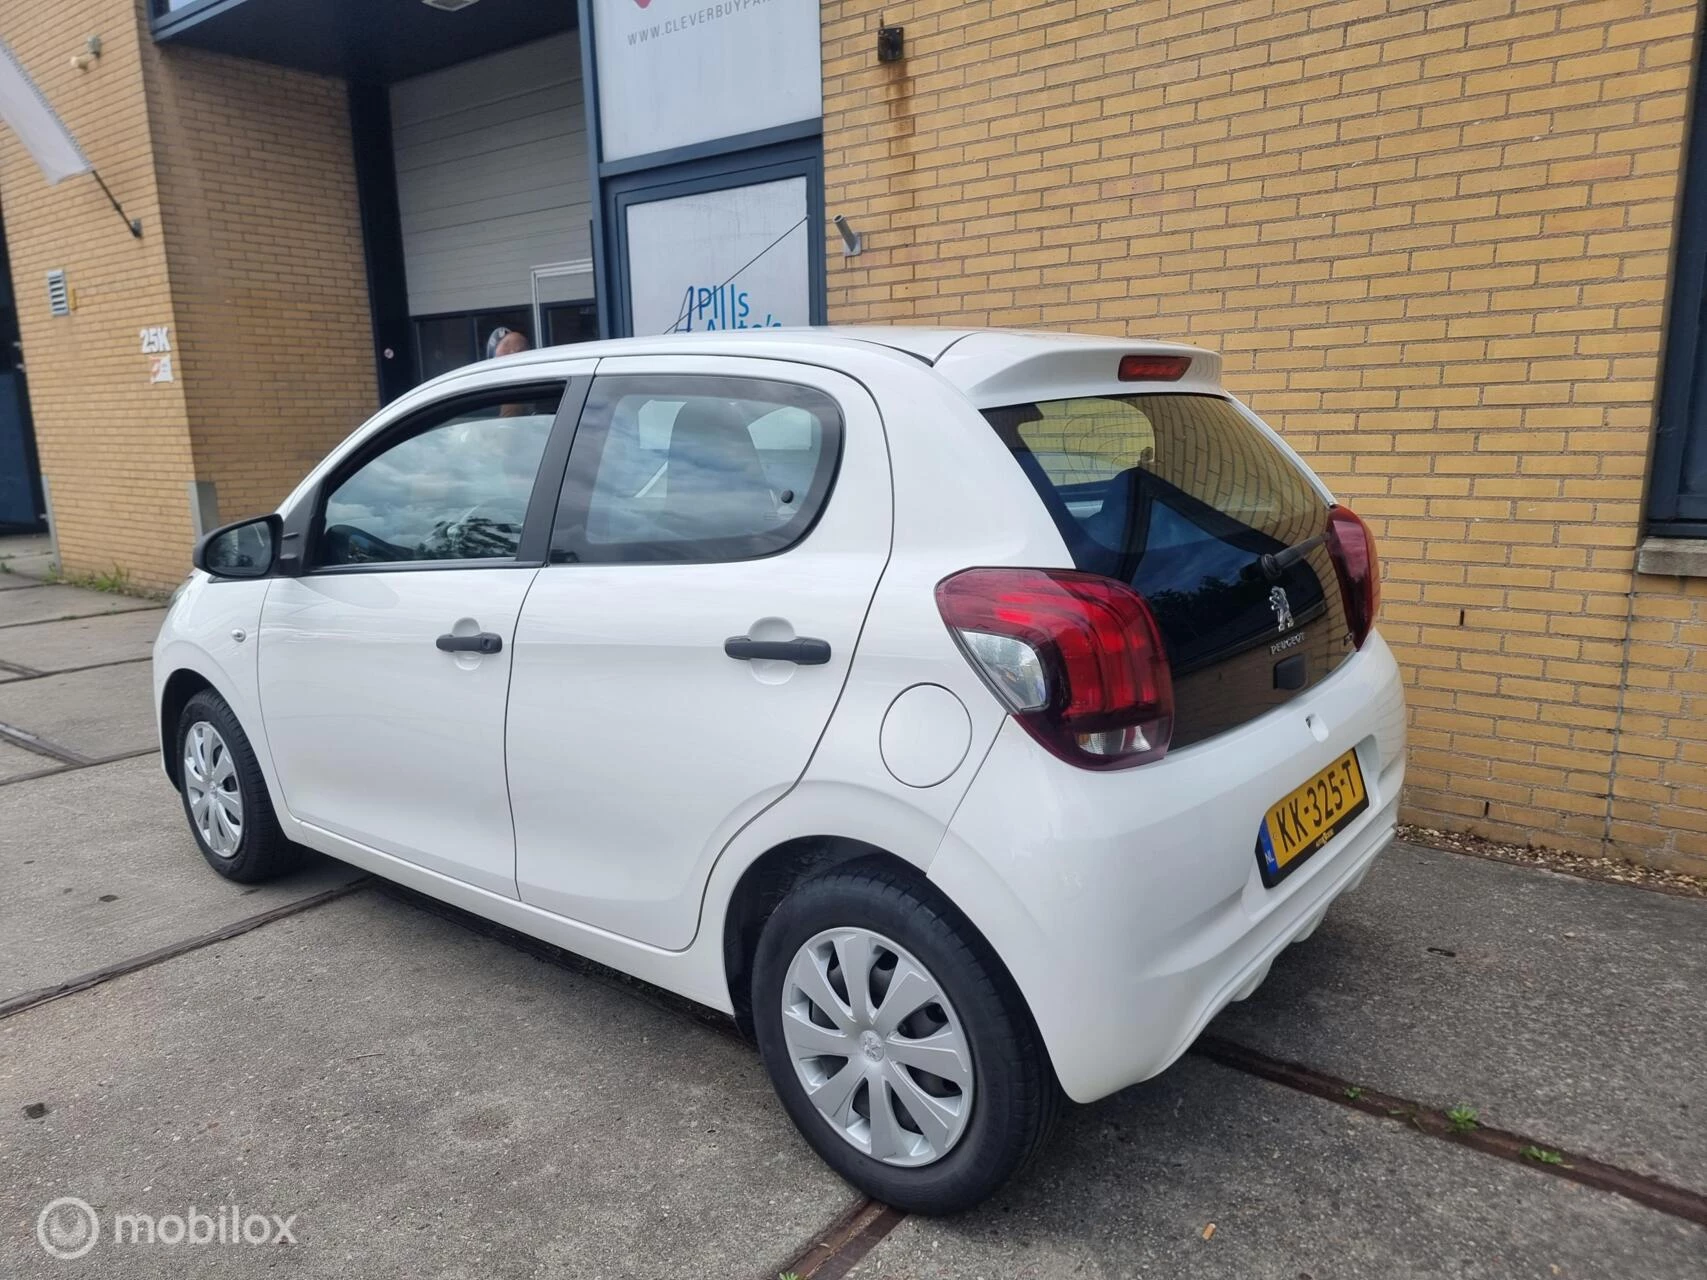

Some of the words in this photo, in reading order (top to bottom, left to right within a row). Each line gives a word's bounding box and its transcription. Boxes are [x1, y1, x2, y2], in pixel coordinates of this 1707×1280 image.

[627, 0, 773, 46] WWW.CLEVERBUYPA
[140, 327, 172, 353] 25K
[1271, 632, 1304, 654] PEUGEOT
[1276, 763, 1356, 853] KK-325-T
[1264, 849, 1275, 865] NL
